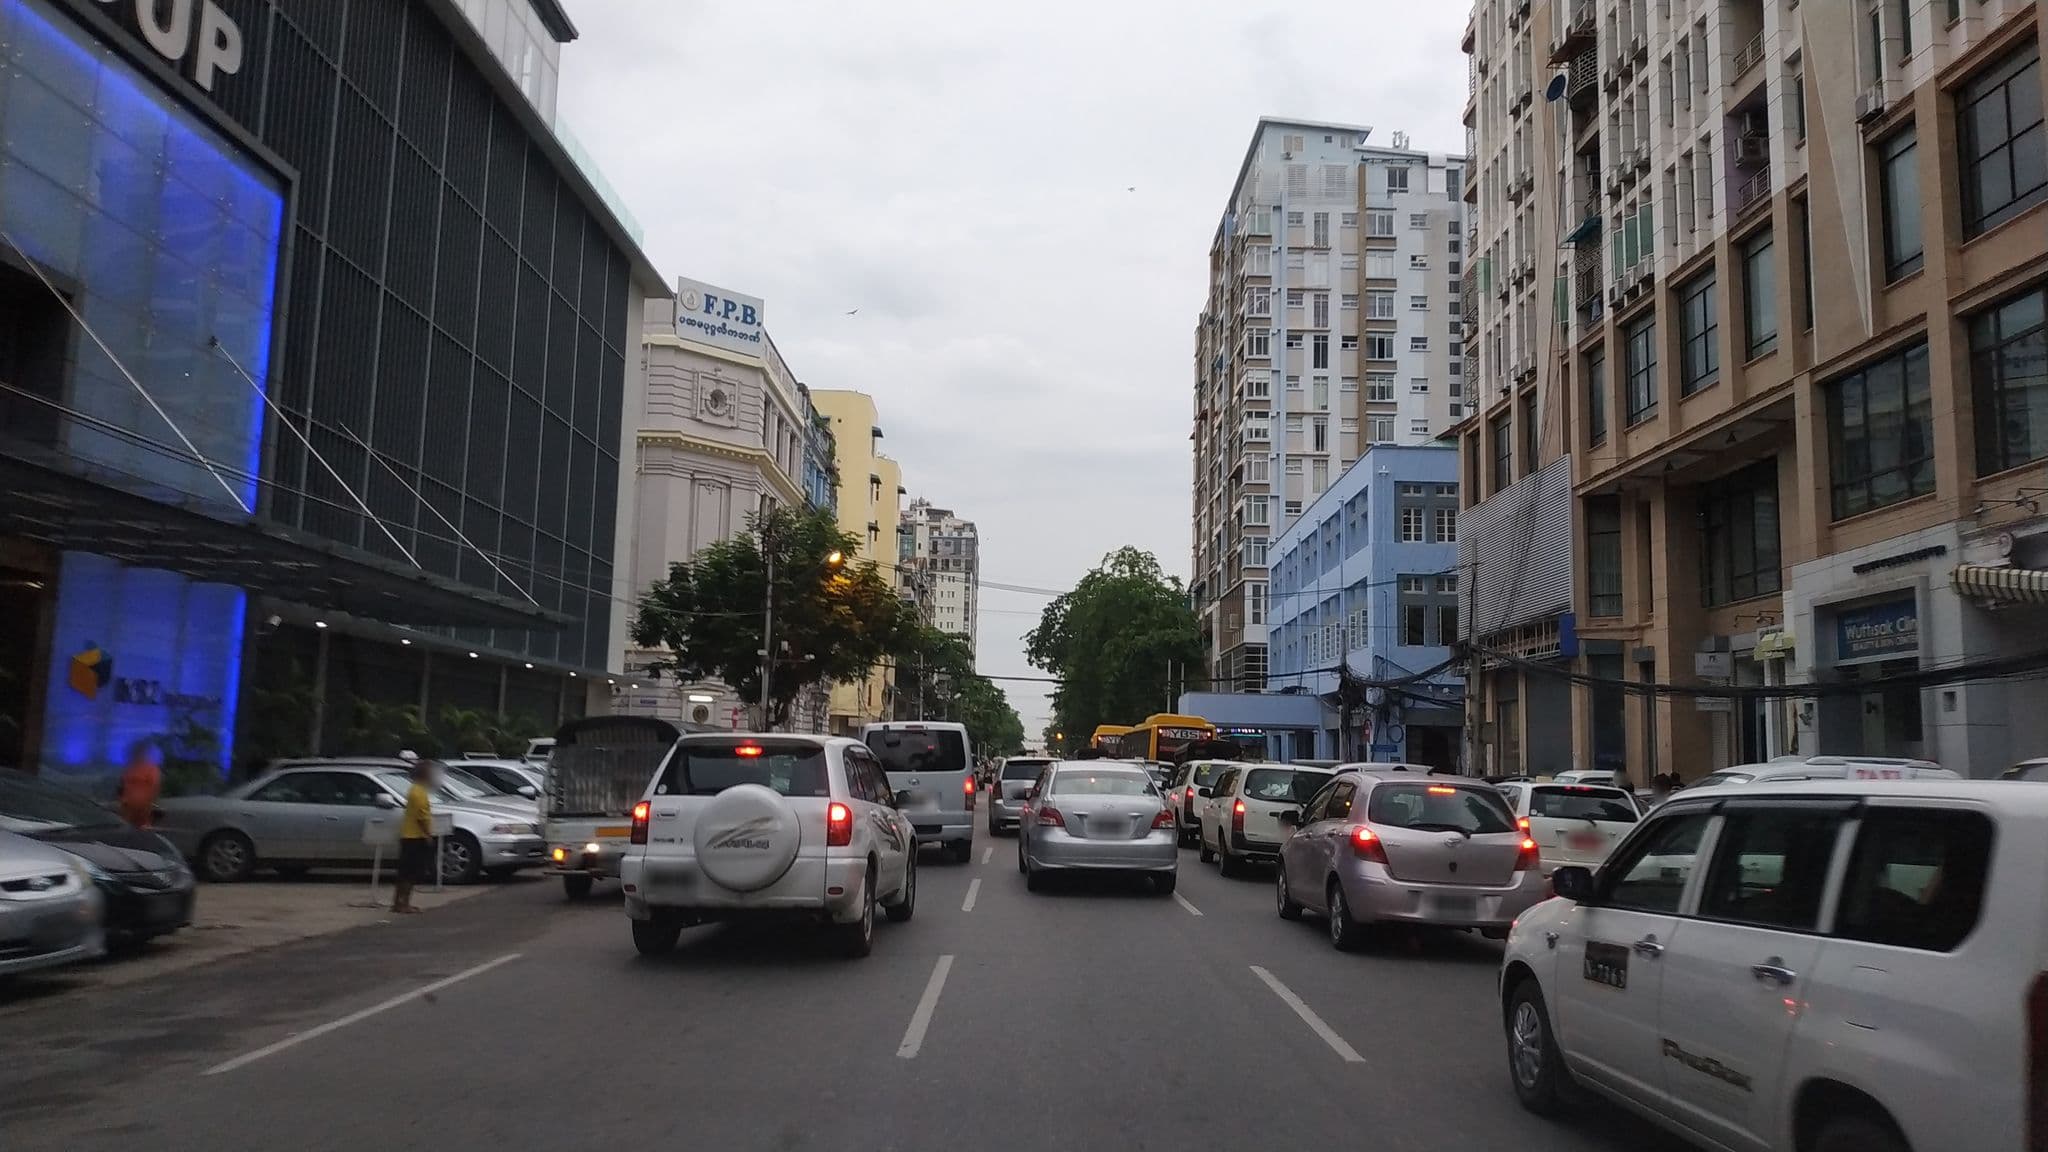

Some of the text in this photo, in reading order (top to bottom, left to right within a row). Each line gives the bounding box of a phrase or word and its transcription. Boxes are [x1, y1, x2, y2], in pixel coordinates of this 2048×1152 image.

[97, 0, 242, 92] UP
[703, 293, 762, 327] F.P.B.
[1170, 728, 1200, 739] YBS
[1856, 769, 1901, 780] TAXI
